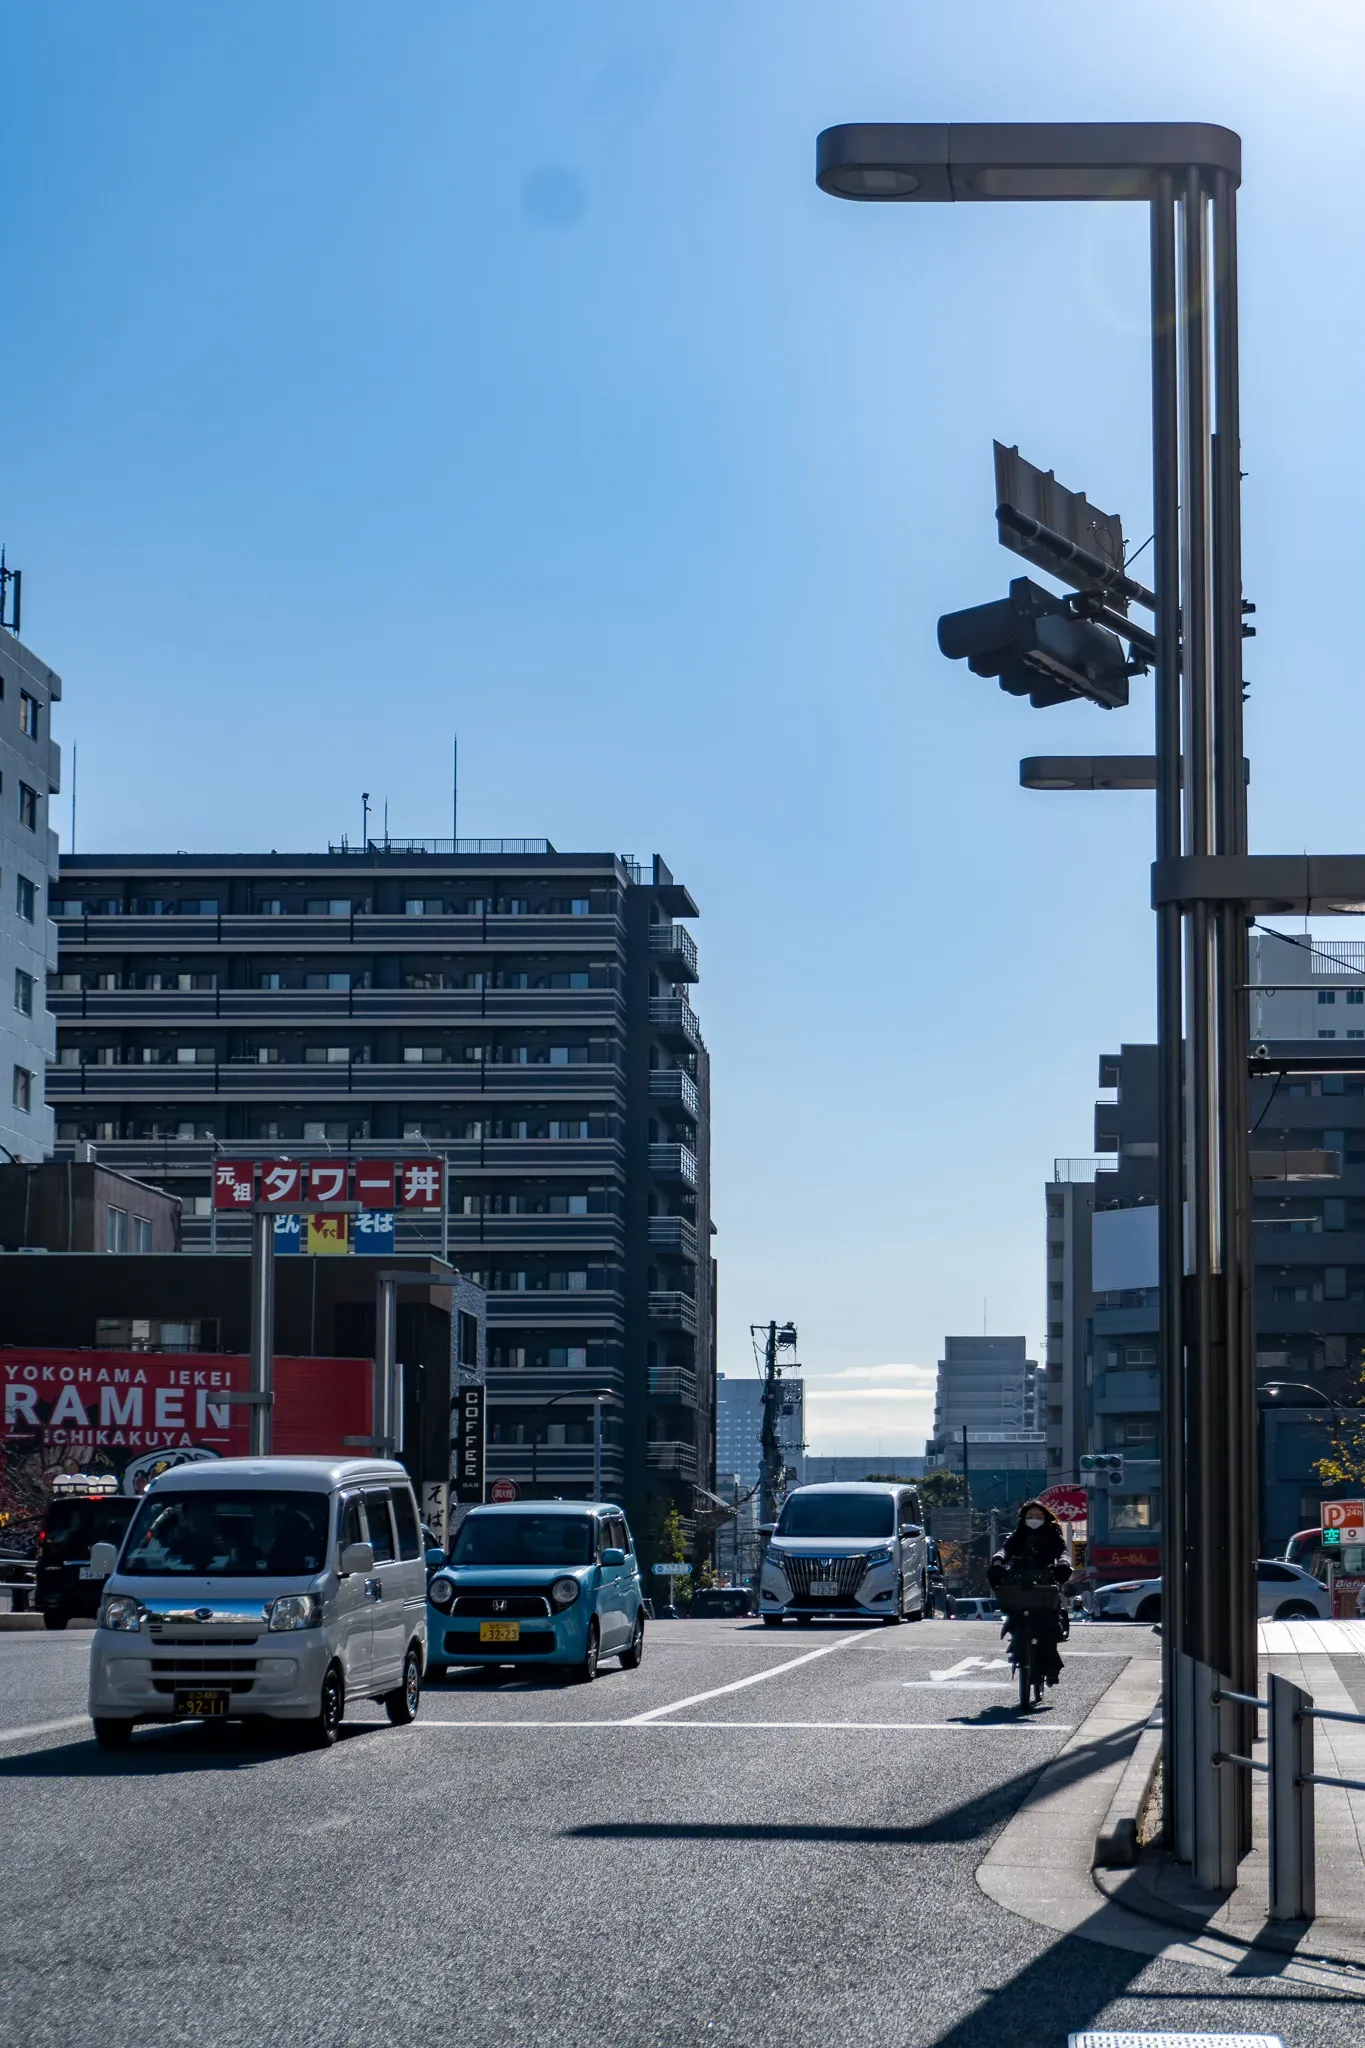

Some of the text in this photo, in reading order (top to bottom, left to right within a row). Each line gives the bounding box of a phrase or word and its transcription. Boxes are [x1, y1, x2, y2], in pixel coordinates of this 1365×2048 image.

[216, 1167, 439, 1201] 元祖 タワー丼
[273, 1214, 300, 1234] どん
[355, 1213, 394, 1233] そば
[4, 1365, 231, 1386] YOKOHAMA IEKEI
[5, 1383, 231, 1428] RAMEN
[43, 1429, 193, 1447] ICHIKAKUYA
[465, 1392, 479, 1476] COFFEE
[1346, 1508, 1362, 1517] 24h
[488, 1630, 517, 1640] 32-23
[186, 1700, 224, 1714] 92-11
